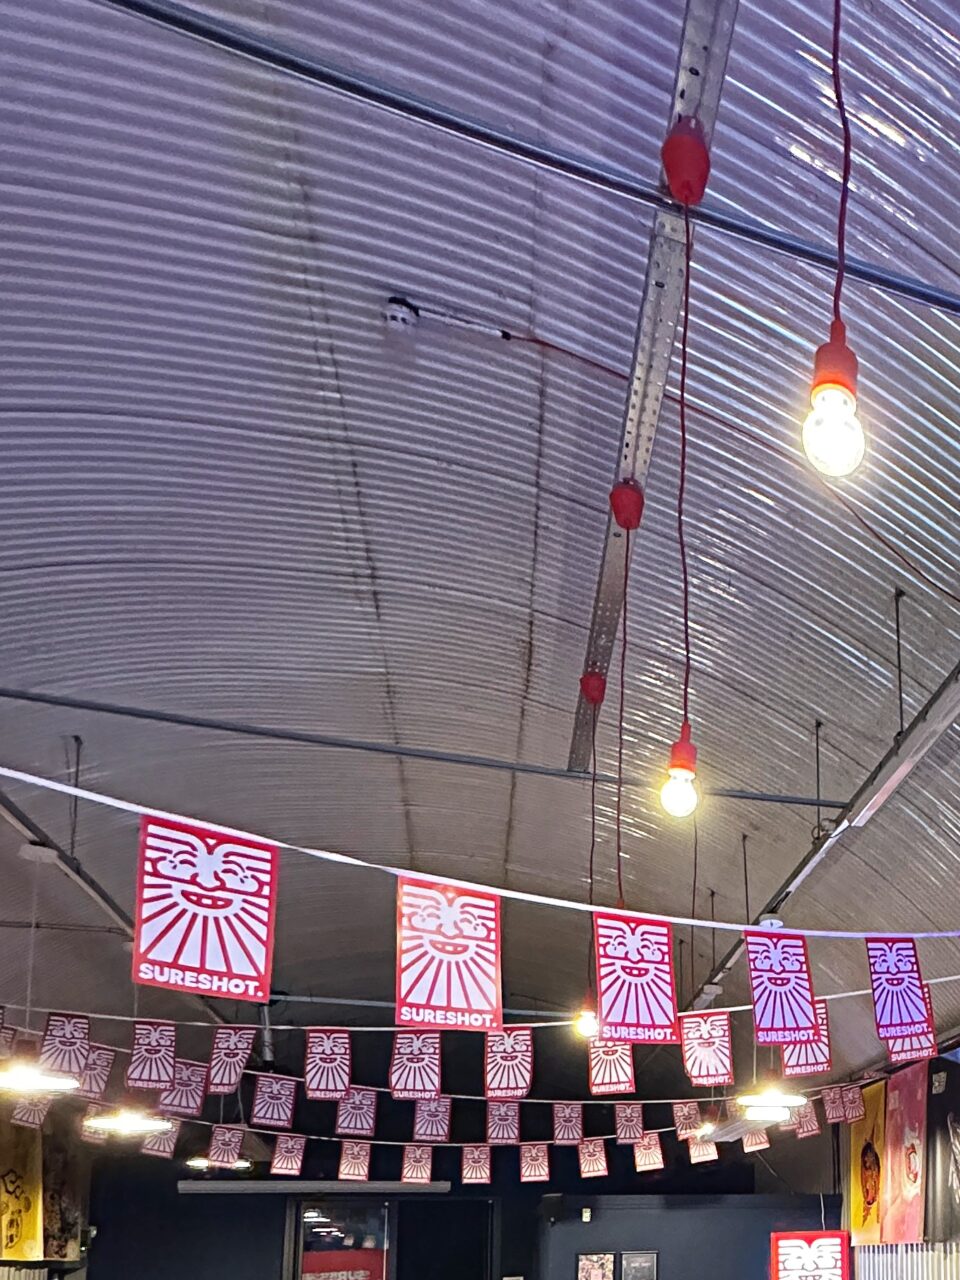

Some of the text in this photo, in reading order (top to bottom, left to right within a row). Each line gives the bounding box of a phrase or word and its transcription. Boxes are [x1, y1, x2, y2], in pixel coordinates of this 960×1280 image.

[138, 963, 264, 997] SURESHOT.
[400, 1006, 498, 1028] SURESHOT.
[603, 1025, 677, 1041] SURESHOT.
[757, 1029, 818, 1043] SURESHOT.
[879, 1022, 933, 1038] SURESHOT.
[891, 1049, 936, 1062] SURESHOT.
[785, 1064, 831, 1076] SURESHOT.
[128, 1080, 174, 1090] SURESHOT.
[393, 1090, 438, 1099] SURESHOT.
